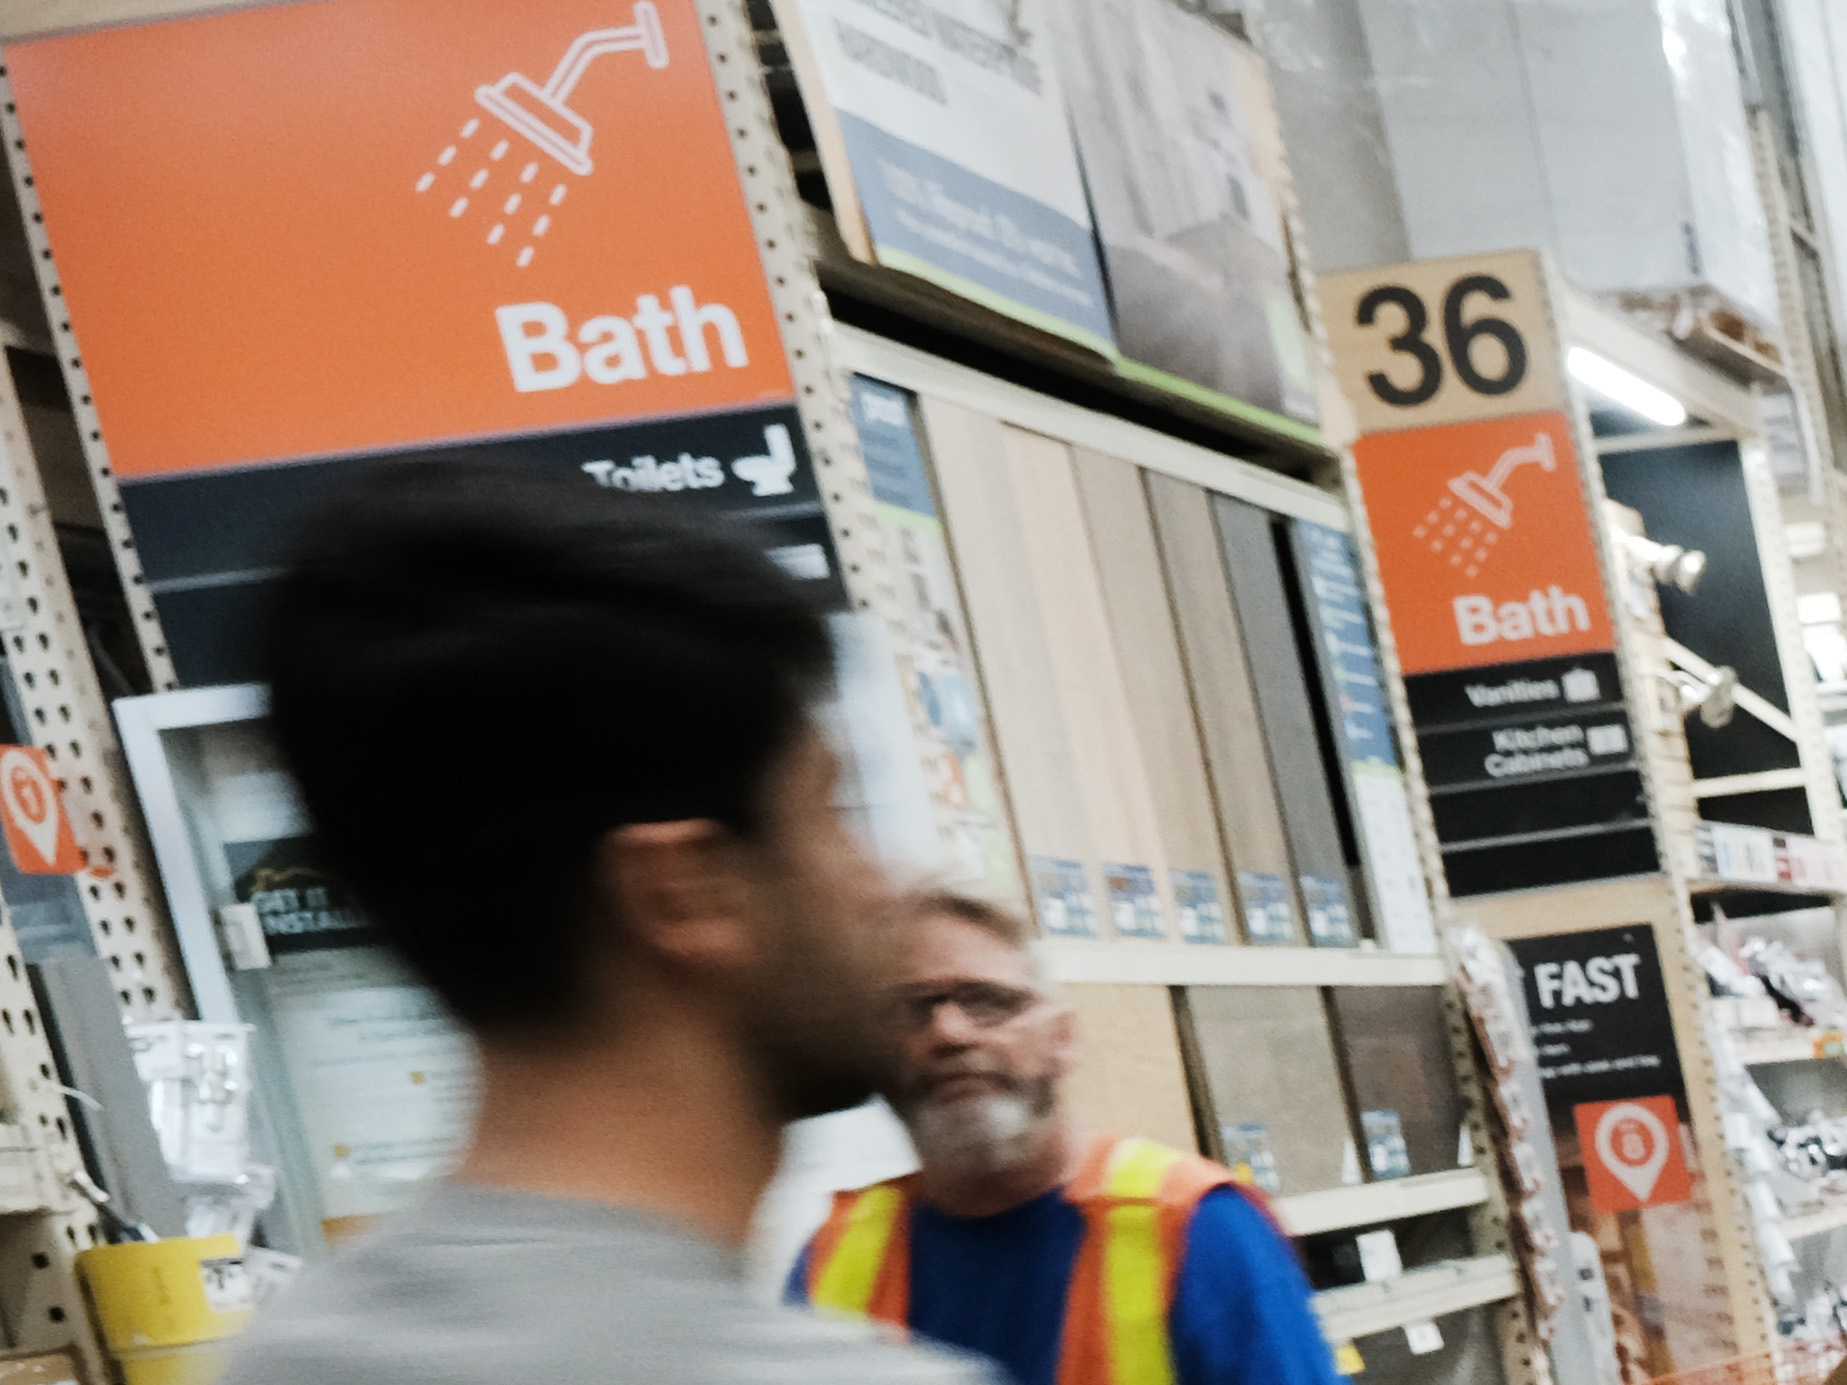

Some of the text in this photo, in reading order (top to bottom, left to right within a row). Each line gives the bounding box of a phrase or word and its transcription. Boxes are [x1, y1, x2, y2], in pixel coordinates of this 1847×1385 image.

[496, 286, 748, 392] Bath
[1356, 274, 1528, 407] 36
[1452, 586, 1591, 645] Bath
[1535, 955, 1641, 1008] FAST
